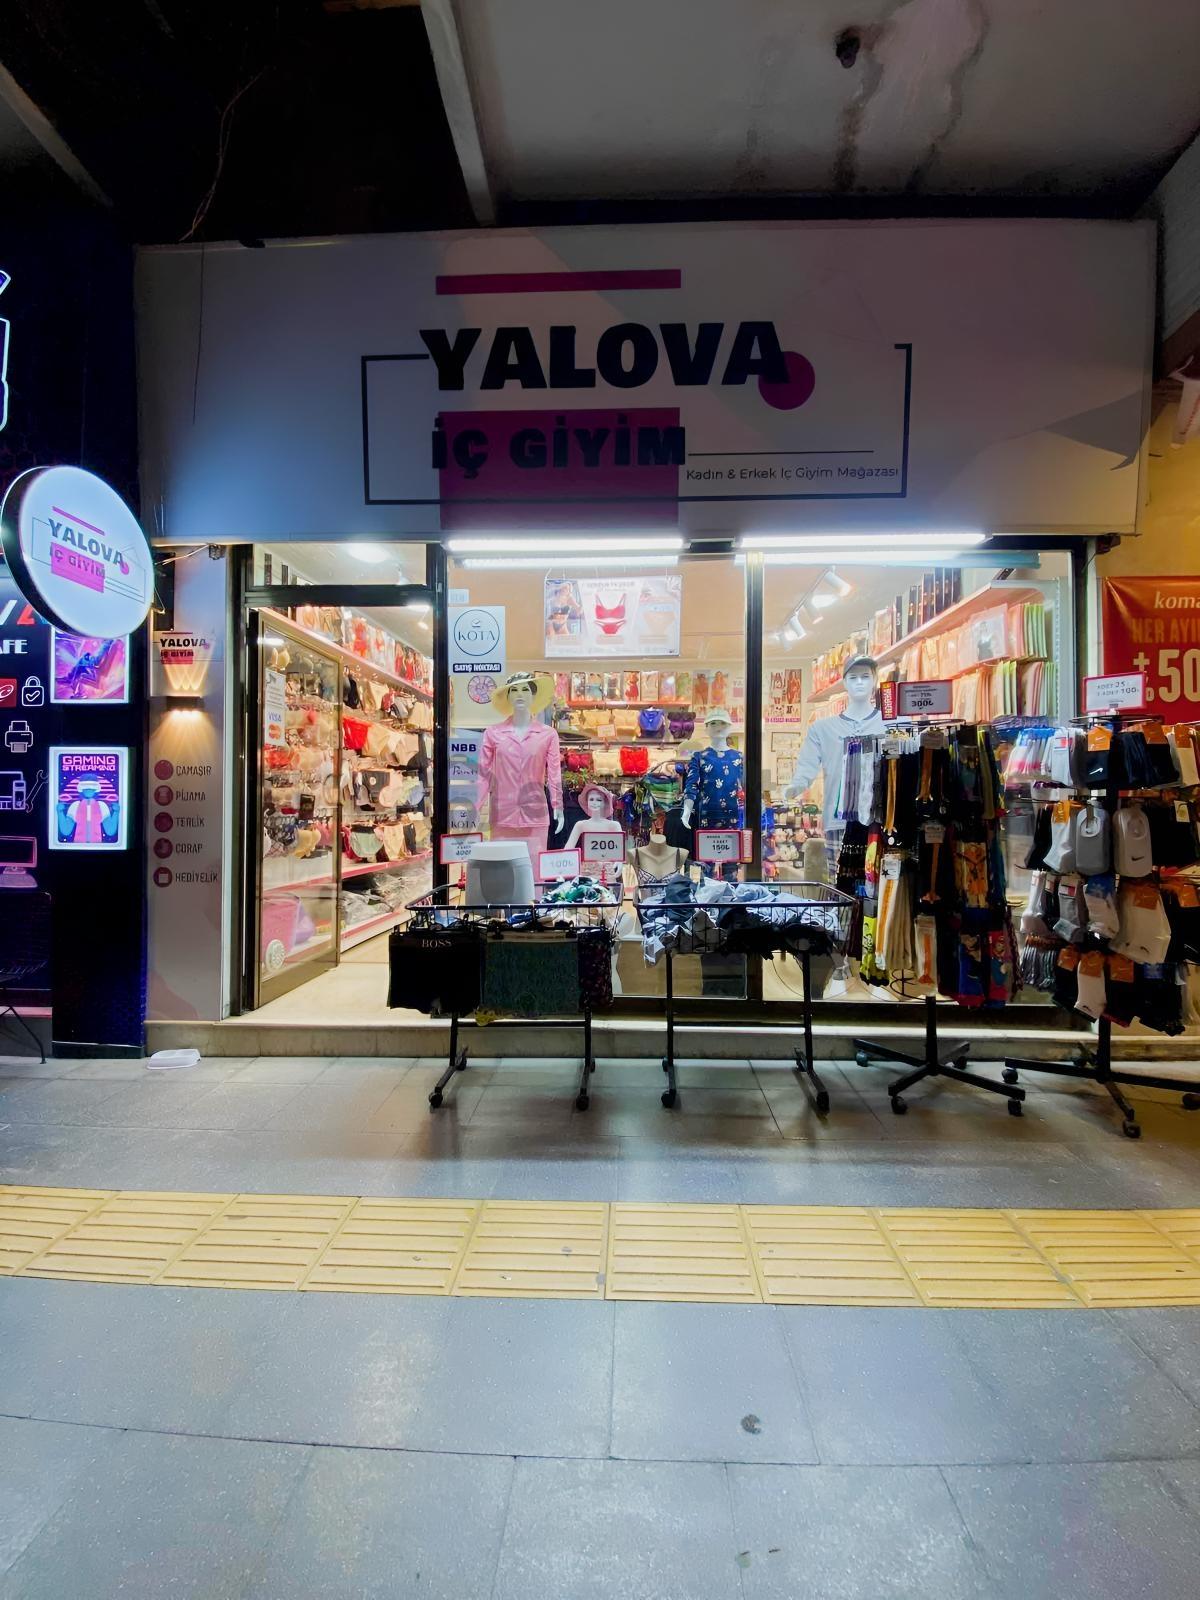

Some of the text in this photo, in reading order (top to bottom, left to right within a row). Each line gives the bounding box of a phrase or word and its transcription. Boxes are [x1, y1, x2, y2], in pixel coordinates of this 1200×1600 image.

[419, 320, 790, 391] YALOVA
[431, 413, 686, 480] İÇ GİYİM
[686, 468, 723, 480] Kadın
[727, 469, 736, 479] &
[740, 467, 776, 480] Erkek
[795, 466, 833, 481] Giyim
[838, 465, 899, 481] Mağazası
[48, 518, 125, 569] YALOVA
[69, 554, 105, 579] GİYİM
[458, 630, 496, 641] KOTA
[1132, 618, 1165, 643] HER
[160, 638, 206, 648] YALOVA
[454, 664, 472, 672] SATIŞ
[451, 743, 477, 752] NBB
[62, 755, 116, 765] GAMING
[175, 789, 206, 801] PİJAMA
[175, 816, 205, 828] TERLİK
[175, 871, 218, 883] HEDİYELİK
[422, 938, 451, 949] BOSS
